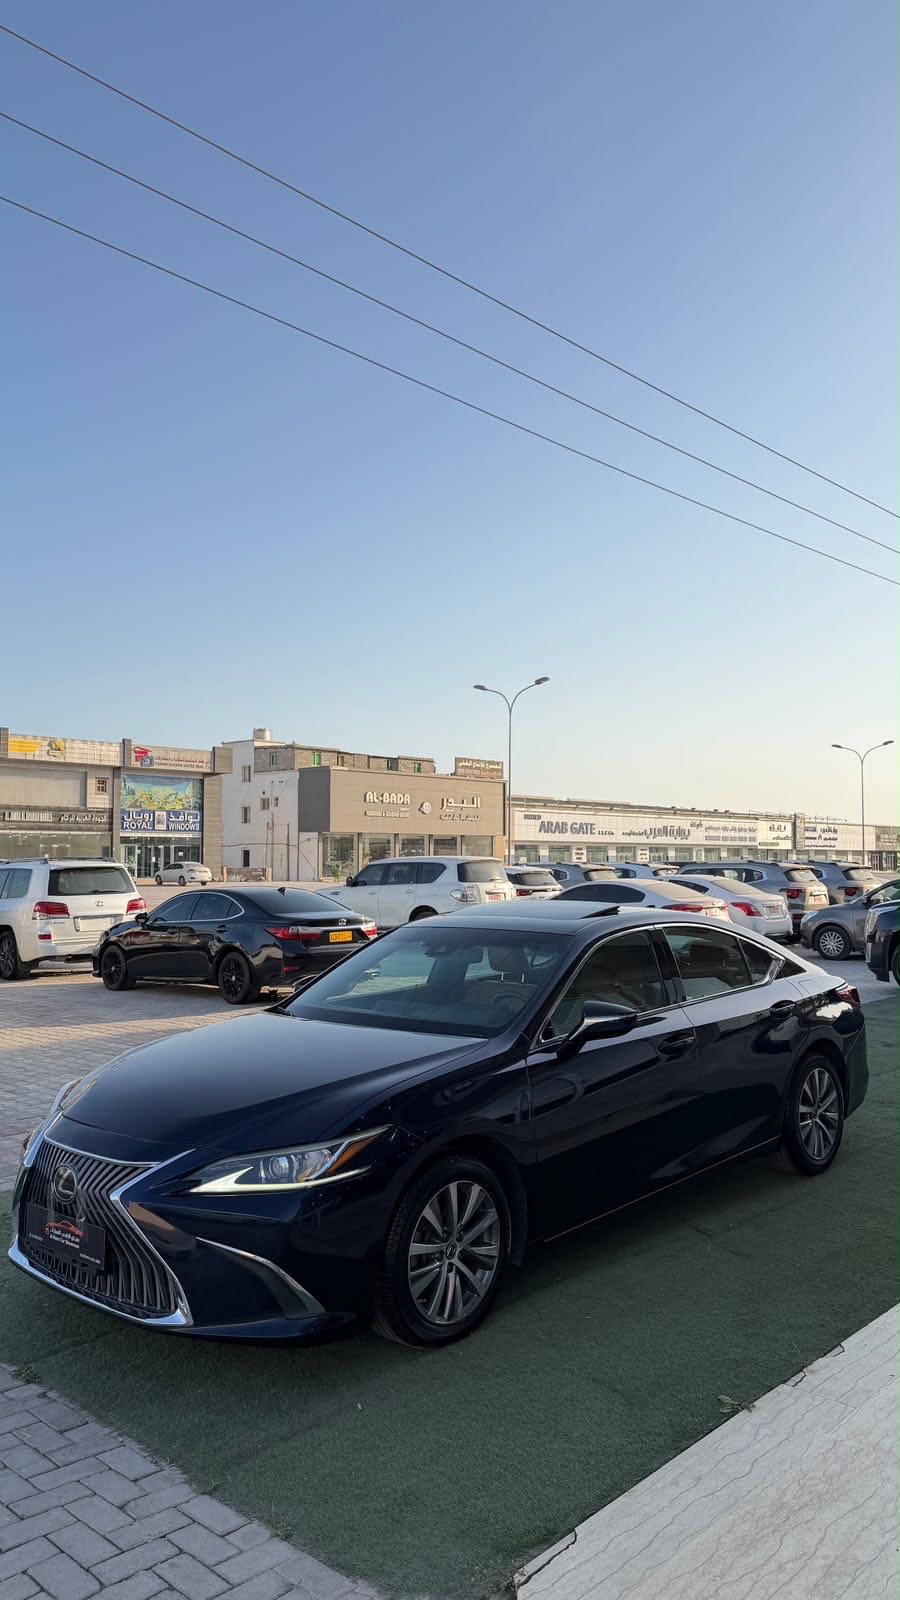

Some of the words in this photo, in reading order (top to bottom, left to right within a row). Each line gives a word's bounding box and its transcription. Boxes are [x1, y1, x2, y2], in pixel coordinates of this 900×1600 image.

[441, 796, 480, 810] البدر
[124, 810, 153, 823] رويال
[169, 811, 200, 823] نوافذ
[123, 822, 153, 830] ROYAL
[168, 823, 200, 831] WINDOWS
[538, 821, 568, 834] ARAB
[570, 822, 596, 835] GATE
